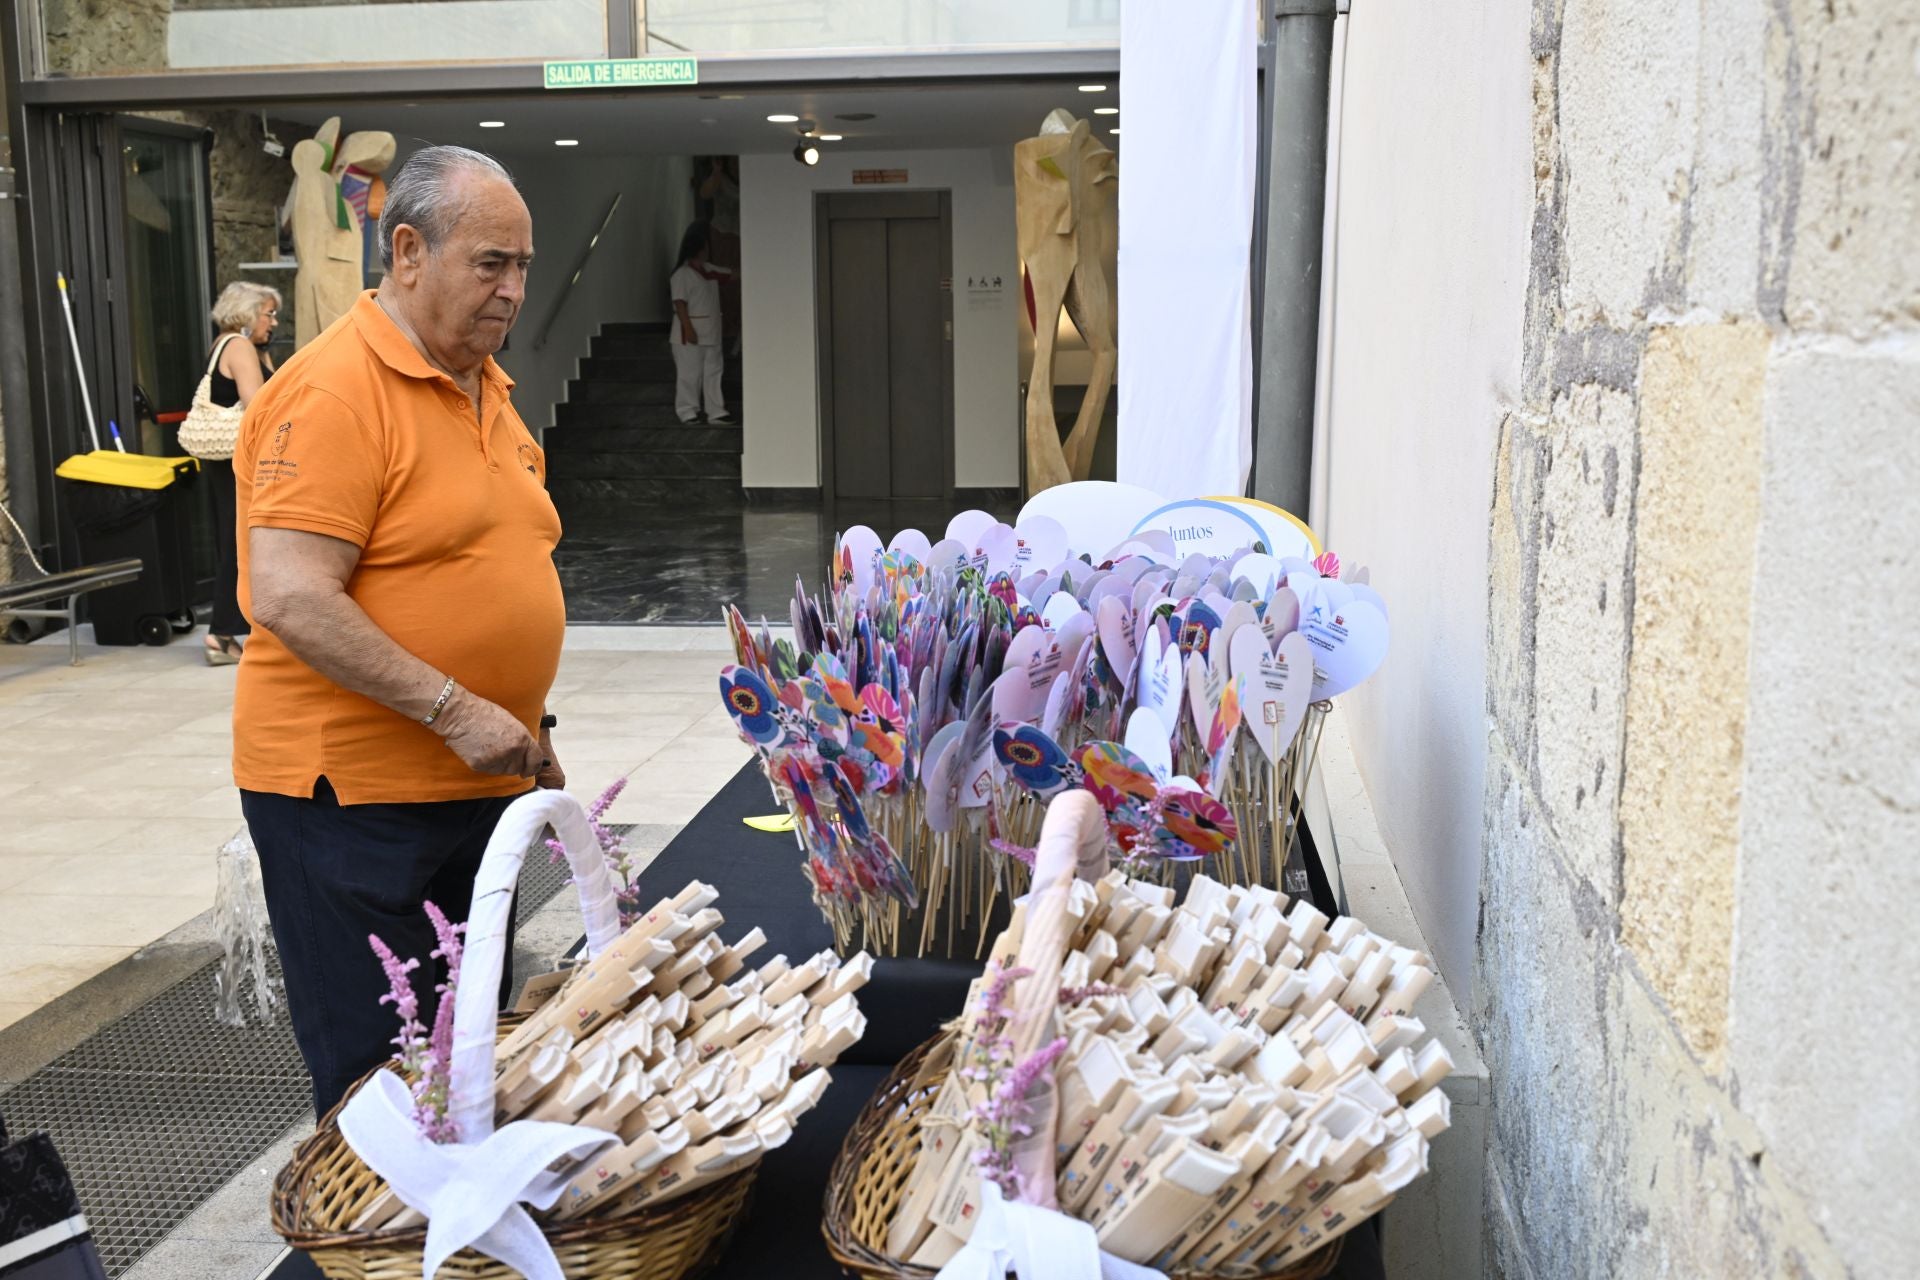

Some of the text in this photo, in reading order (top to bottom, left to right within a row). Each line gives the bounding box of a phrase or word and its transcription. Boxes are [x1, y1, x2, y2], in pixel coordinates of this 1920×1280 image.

[549, 62, 693, 83] SALIDA DE EMERGENCIA
